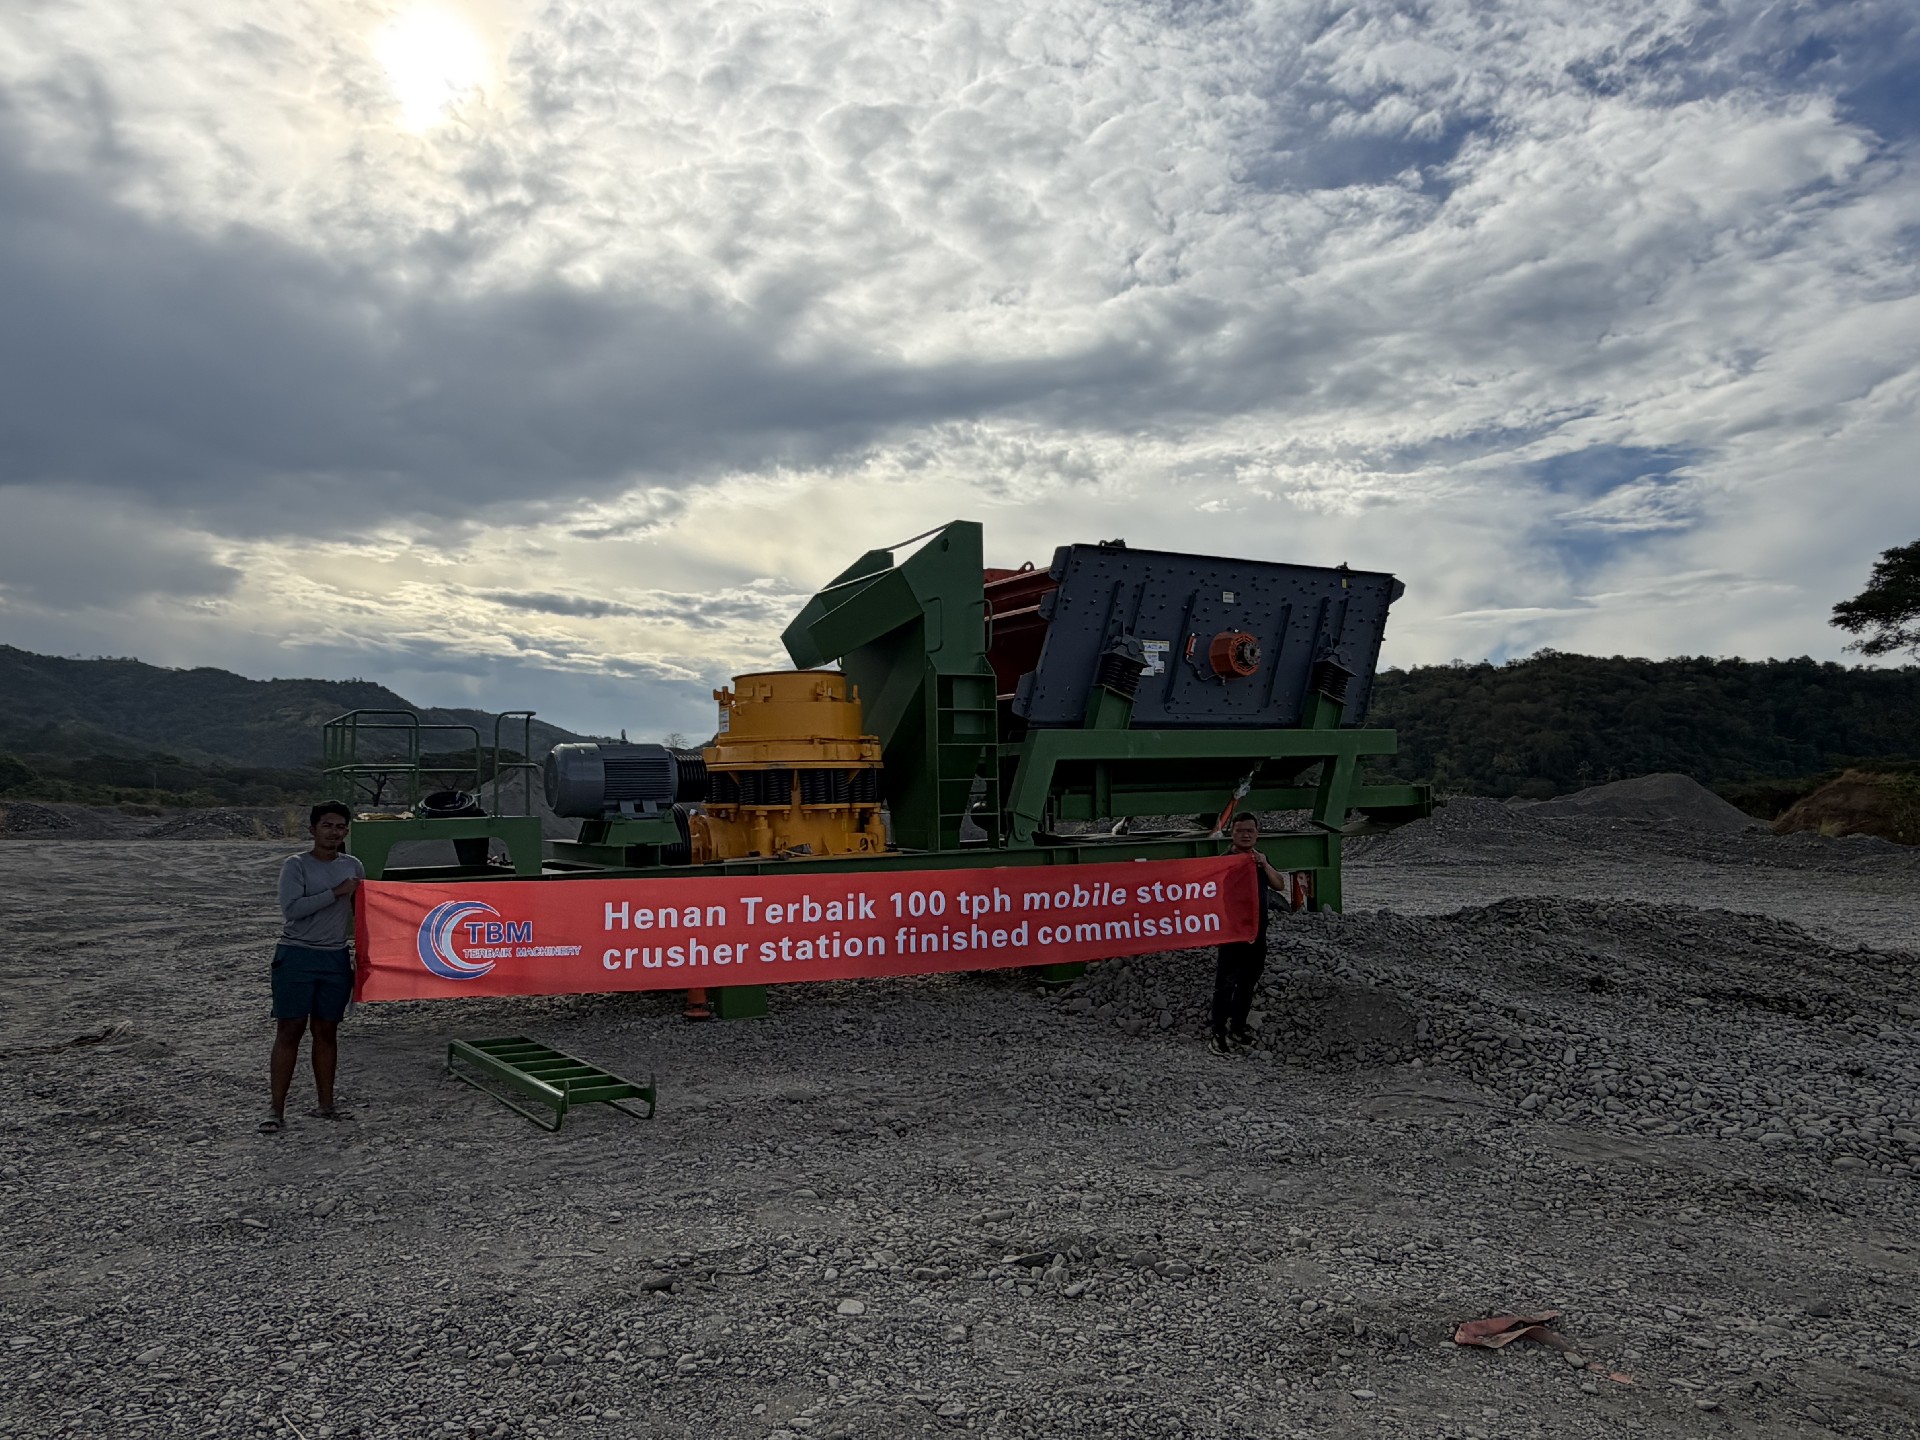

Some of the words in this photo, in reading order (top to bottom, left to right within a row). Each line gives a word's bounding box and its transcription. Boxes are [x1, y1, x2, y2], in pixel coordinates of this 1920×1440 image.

[604, 901, 727, 931] Henan
[740, 892, 877, 925] Terbaik
[889, 890, 946, 918] 100
[956, 887, 1011, 920] tph
[1023, 882, 1127, 911] mobile
[1136, 881, 1217, 904] stone
[463, 920, 533, 945] TBM
[602, 937, 750, 971] crusher
[759, 930, 886, 963] station
[894, 920, 1029, 955] finished
[1037, 909, 1220, 945] commission
[462, 947, 513, 959] TERBAIK
[515, 945, 582, 958] MACHINERY
